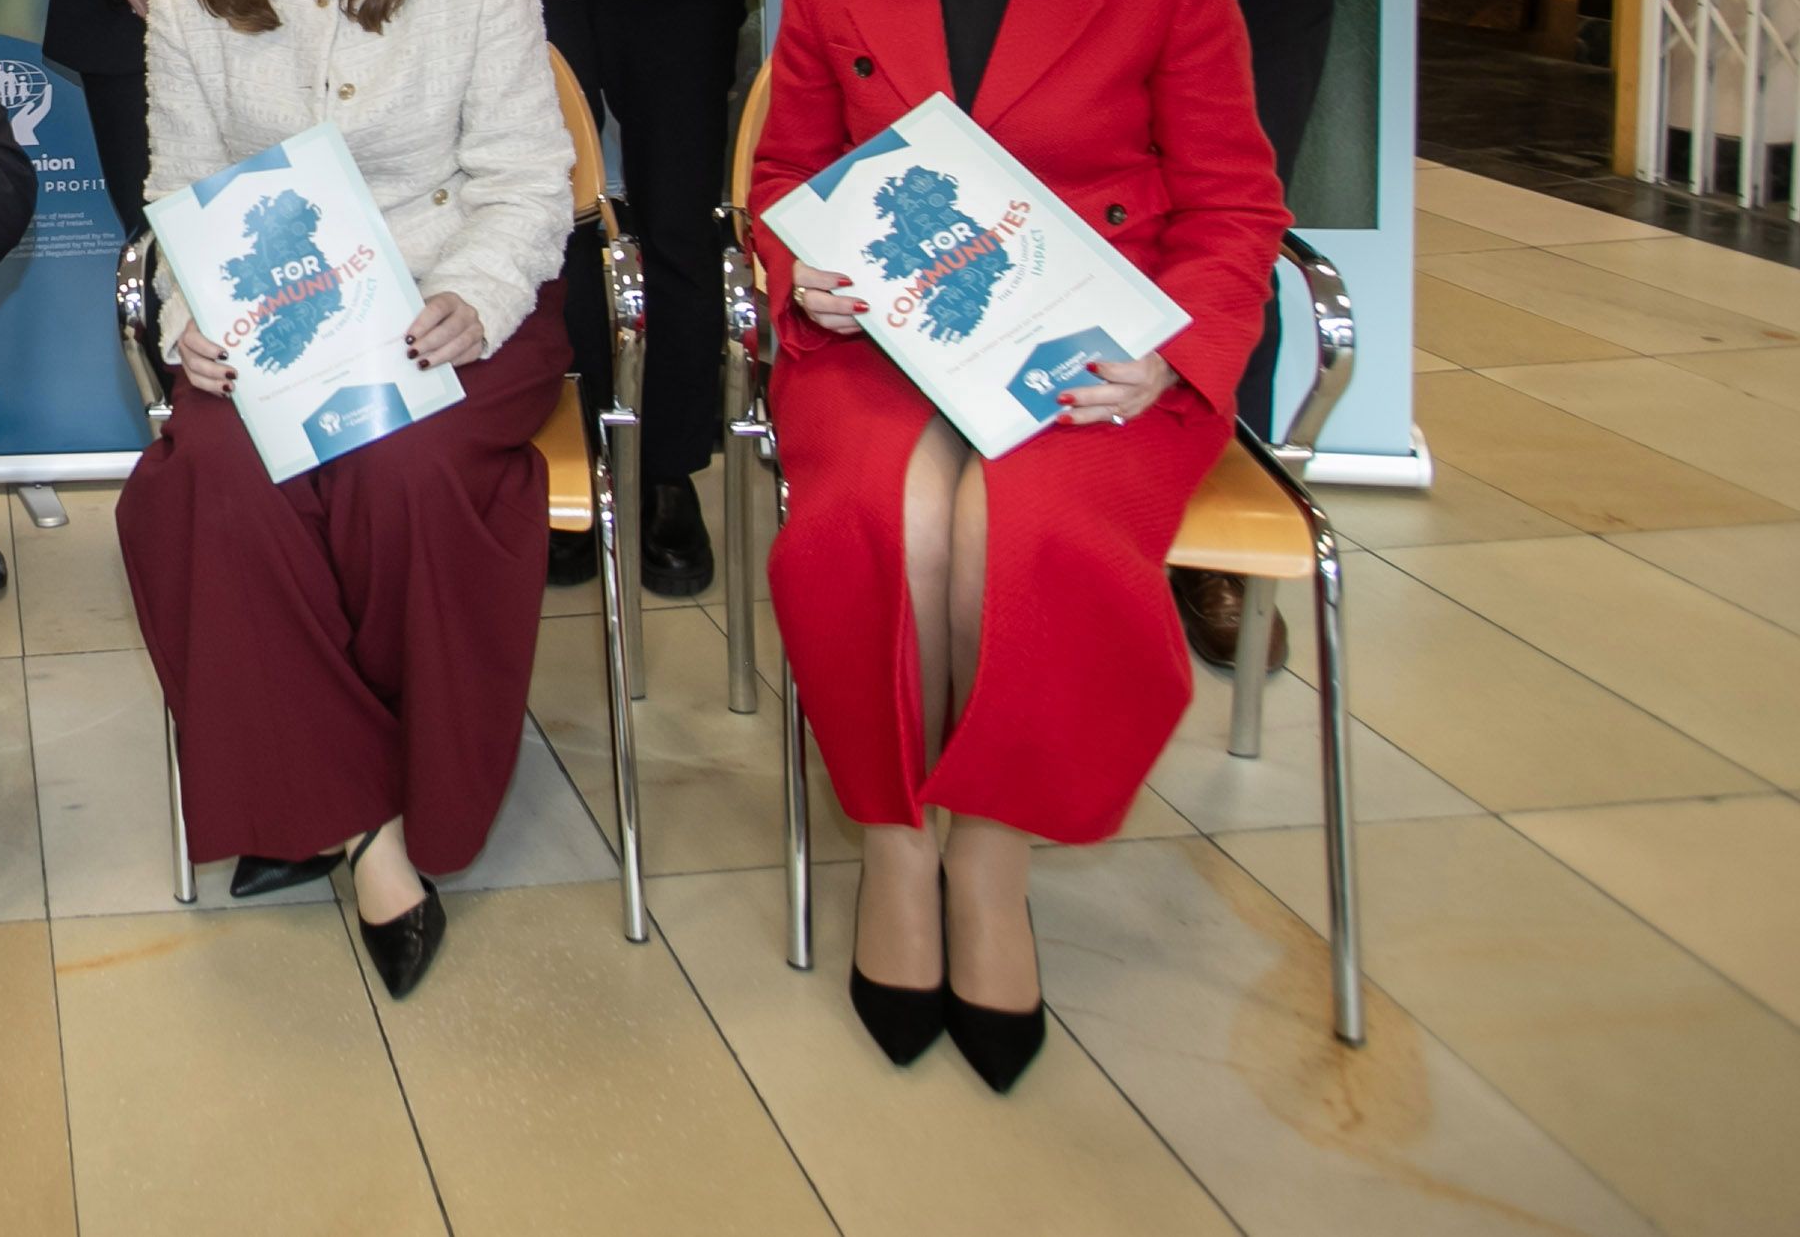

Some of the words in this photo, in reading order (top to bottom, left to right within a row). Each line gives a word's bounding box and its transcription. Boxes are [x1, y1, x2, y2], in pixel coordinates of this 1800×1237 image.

[887, 199, 1032, 329] COMMUNITIES
[918, 222, 977, 259] FOR
[1029, 228, 1046, 277] IMPACT
[270, 254, 322, 287] FOR
[223, 244, 376, 348] COMMUNITIES
